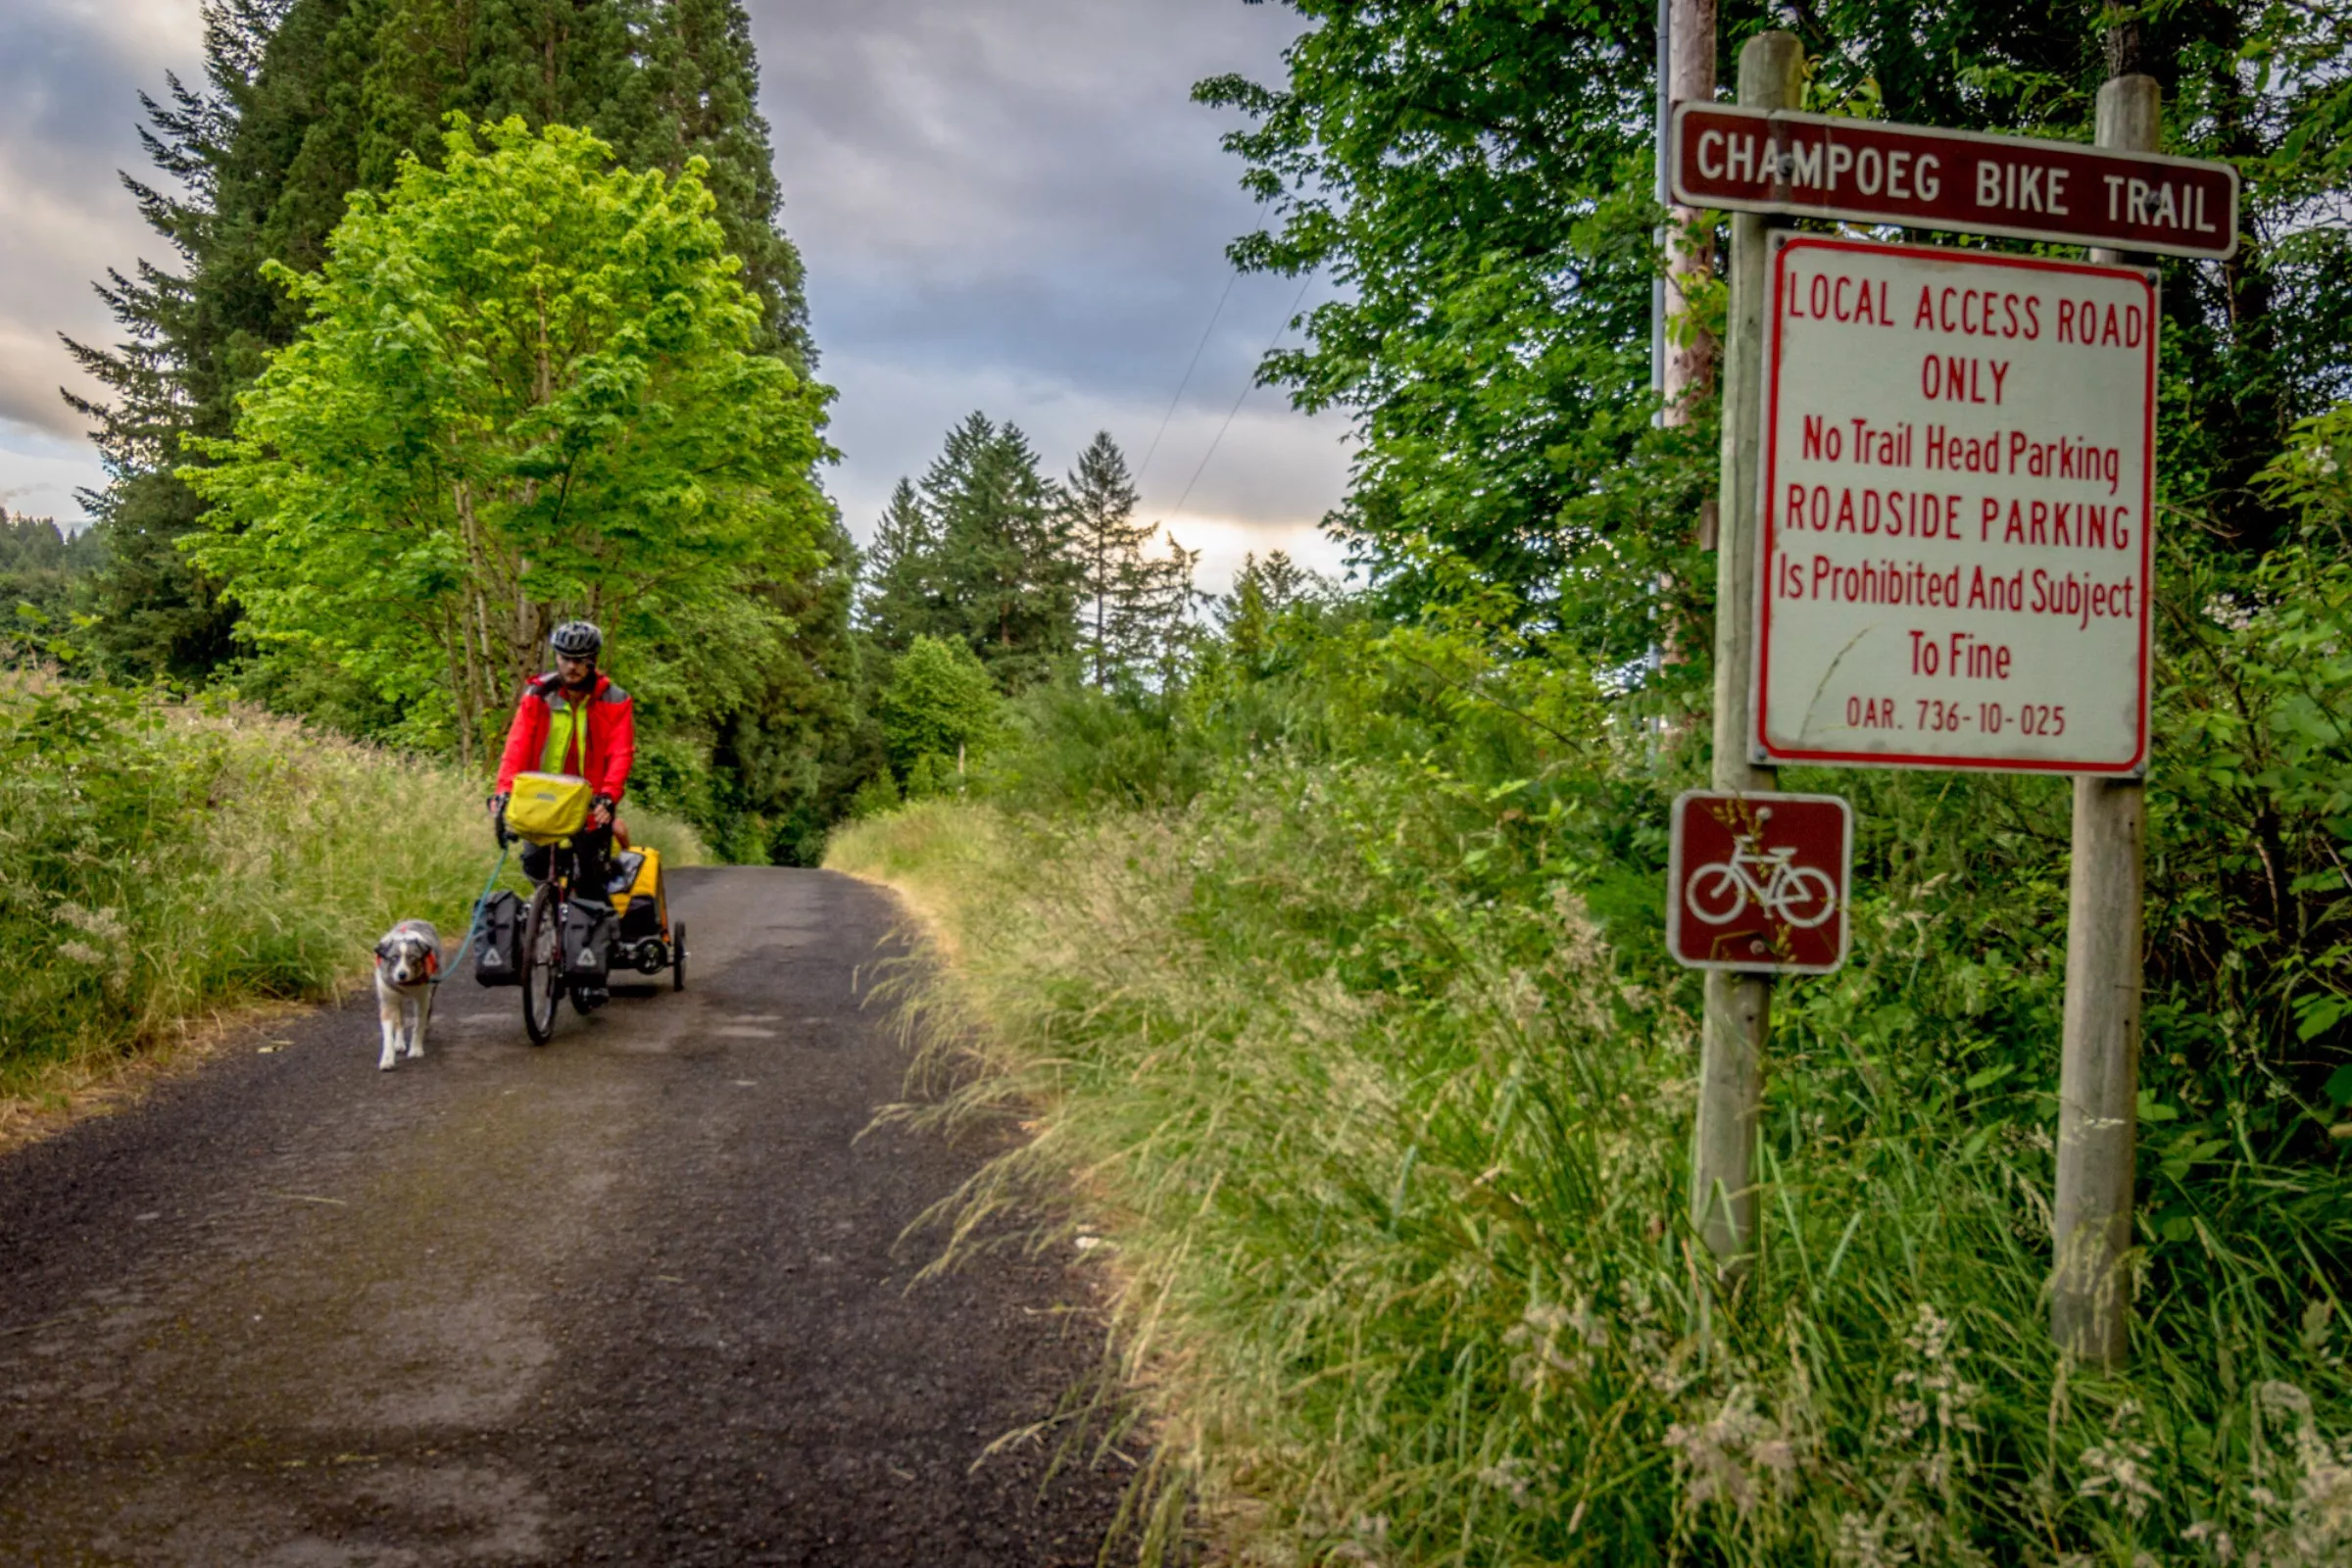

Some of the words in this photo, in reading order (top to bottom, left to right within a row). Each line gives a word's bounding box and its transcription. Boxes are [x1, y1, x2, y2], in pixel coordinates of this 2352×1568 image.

[1697, 129, 1940, 201] CHAMPOEG
[1977, 161, 2070, 215] BIKE
[2104, 174, 2217, 233] TRAIL
[1788, 271, 1894, 326] LOCAL
[1915, 285, 2040, 340] ACCESS
[2058, 299, 2142, 348] ROAD
[1922, 354, 2010, 405] ONLY
[1802, 415, 1840, 462] No
[1850, 419, 1912, 468] Trail
[1926, 425, 1999, 474] Head
[2009, 431, 2120, 494] Parking
[1786, 485, 1962, 540] ROADSIDE
[1981, 497, 2130, 550] PARKING
[1780, 554, 1804, 600] Is
[1812, 555, 1959, 608] Prohibited
[1968, 565, 2023, 612] And
[2031, 568, 2133, 630] Subject
[1909, 630, 1939, 676] To
[1949, 633, 2011, 679] Fine
[1847, 697, 1903, 731] OAR.
